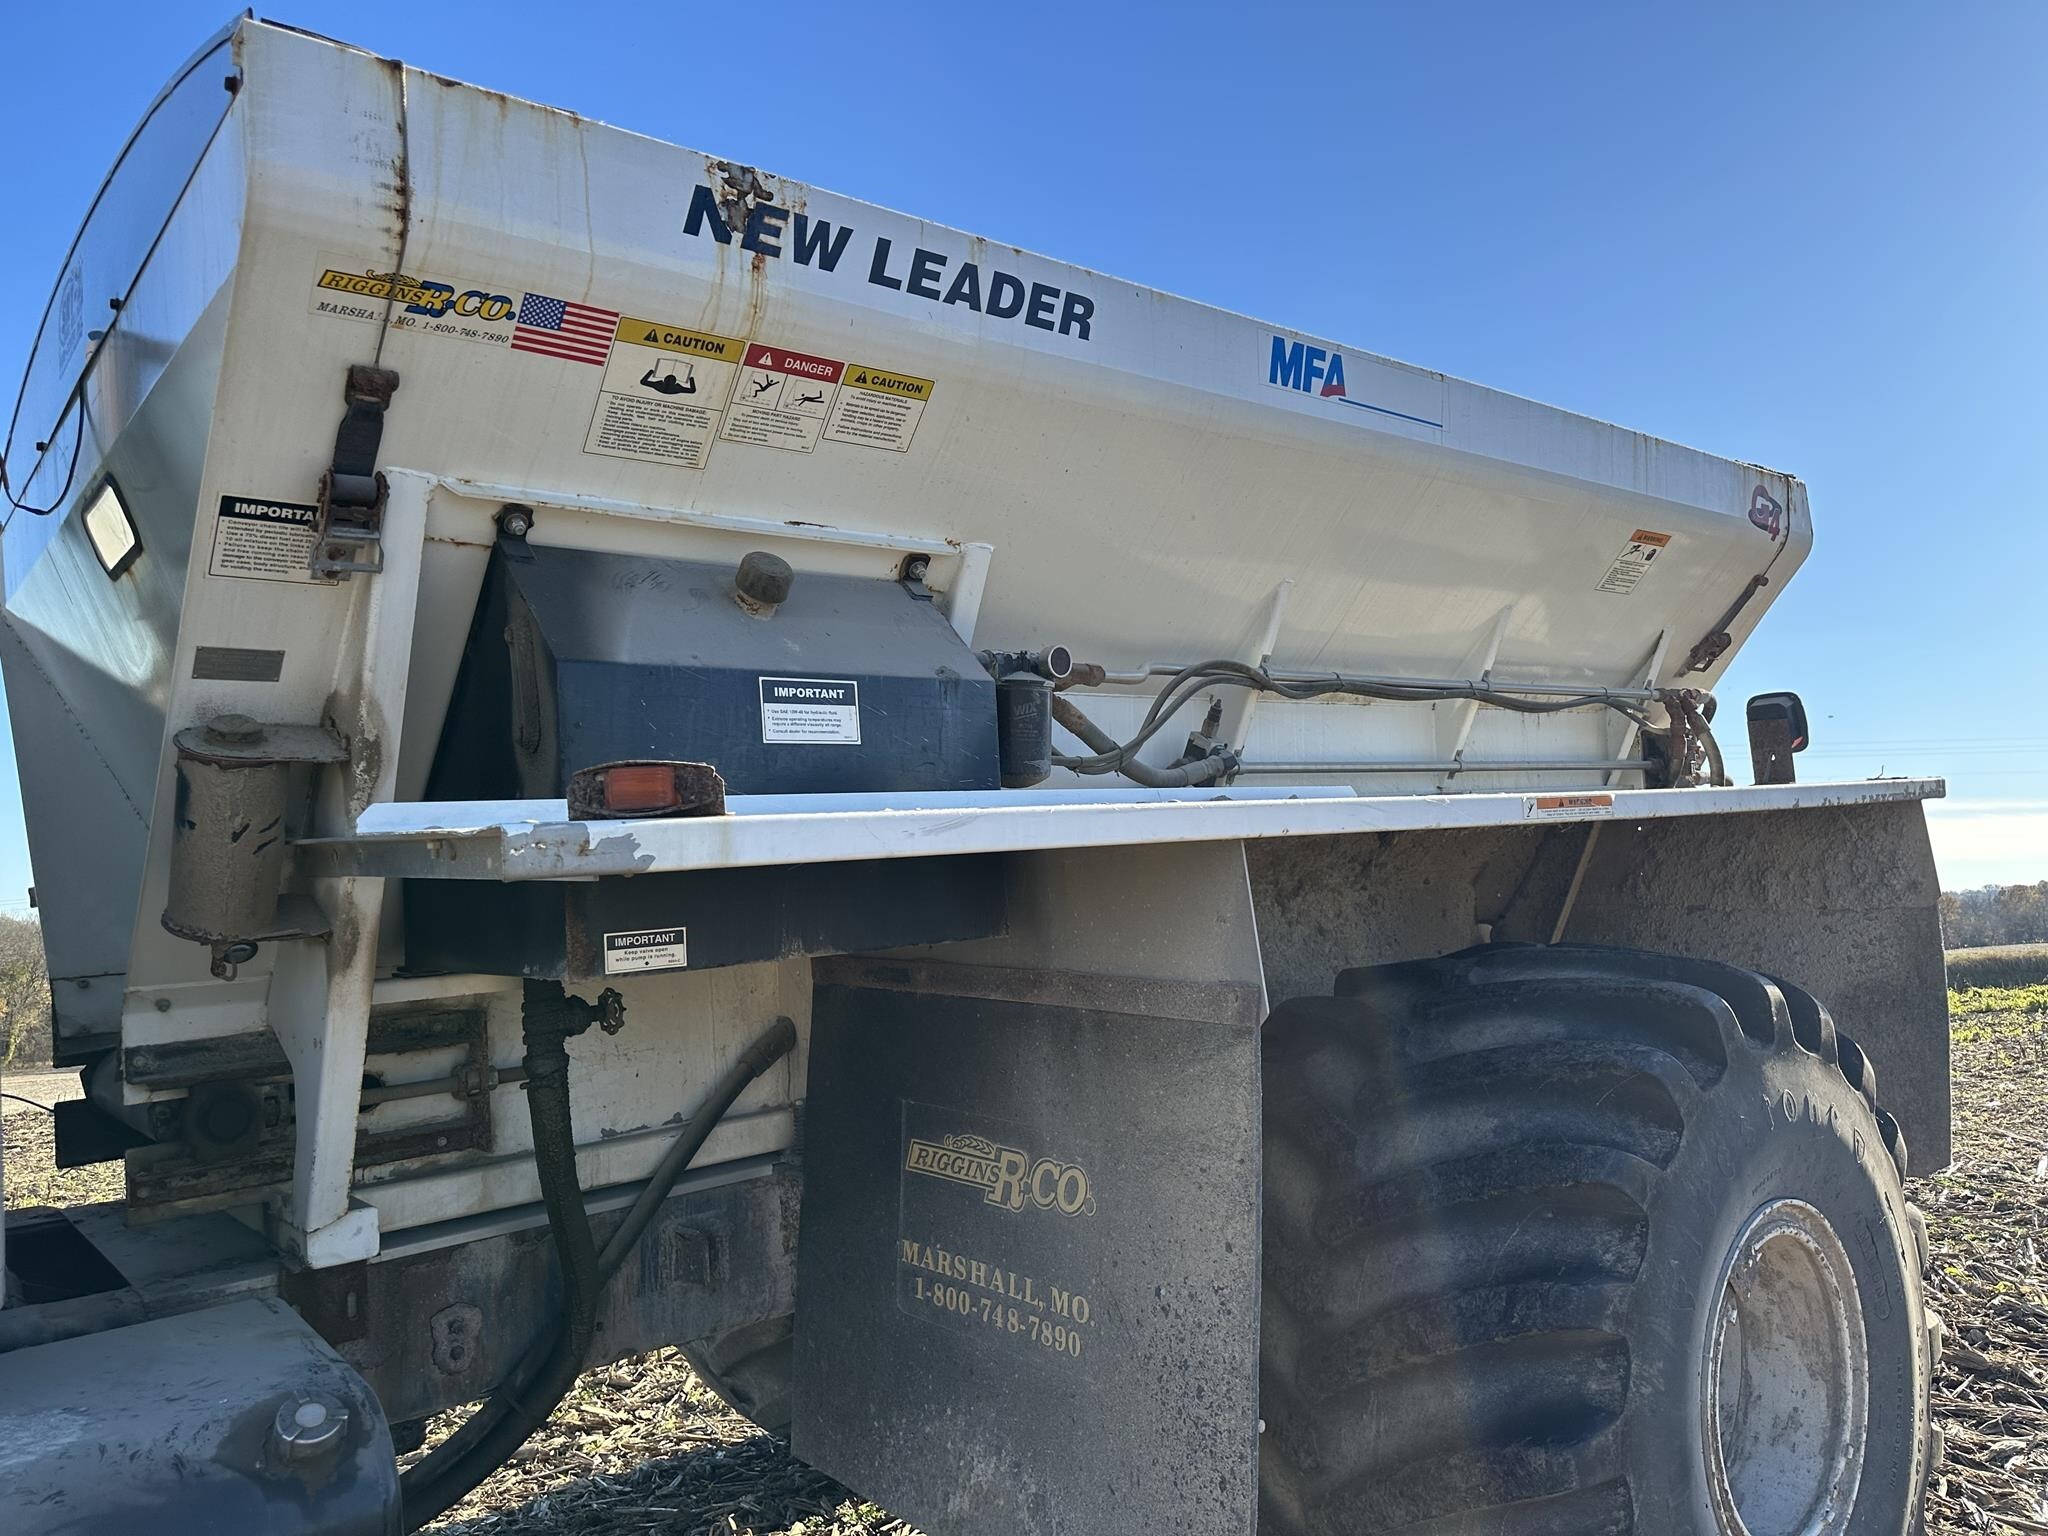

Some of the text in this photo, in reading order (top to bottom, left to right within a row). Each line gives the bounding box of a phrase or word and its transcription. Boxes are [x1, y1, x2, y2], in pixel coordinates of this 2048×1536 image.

[683, 184, 1095, 341] NEW LEADER
[325, 273, 426, 303] RIGGINS
[423, 322, 509, 344] 1-800-748-7890
[663, 332, 725, 354] CAUTION
[784, 358, 833, 377] DANGER
[1269, 336, 1346, 397] MFA
[871, 375, 924, 395] CAUTION
[234, 502, 319, 521] IMPORTA
[774, 687, 844, 699] IMPORTANT
[615, 933, 675, 947] IMPORTANT
[913, 1147, 1001, 1184] RIGGINS
[902, 1239, 1096, 1328] MARSHALL, MO.
[915, 1277, 1082, 1357] 1-800-748-7890
